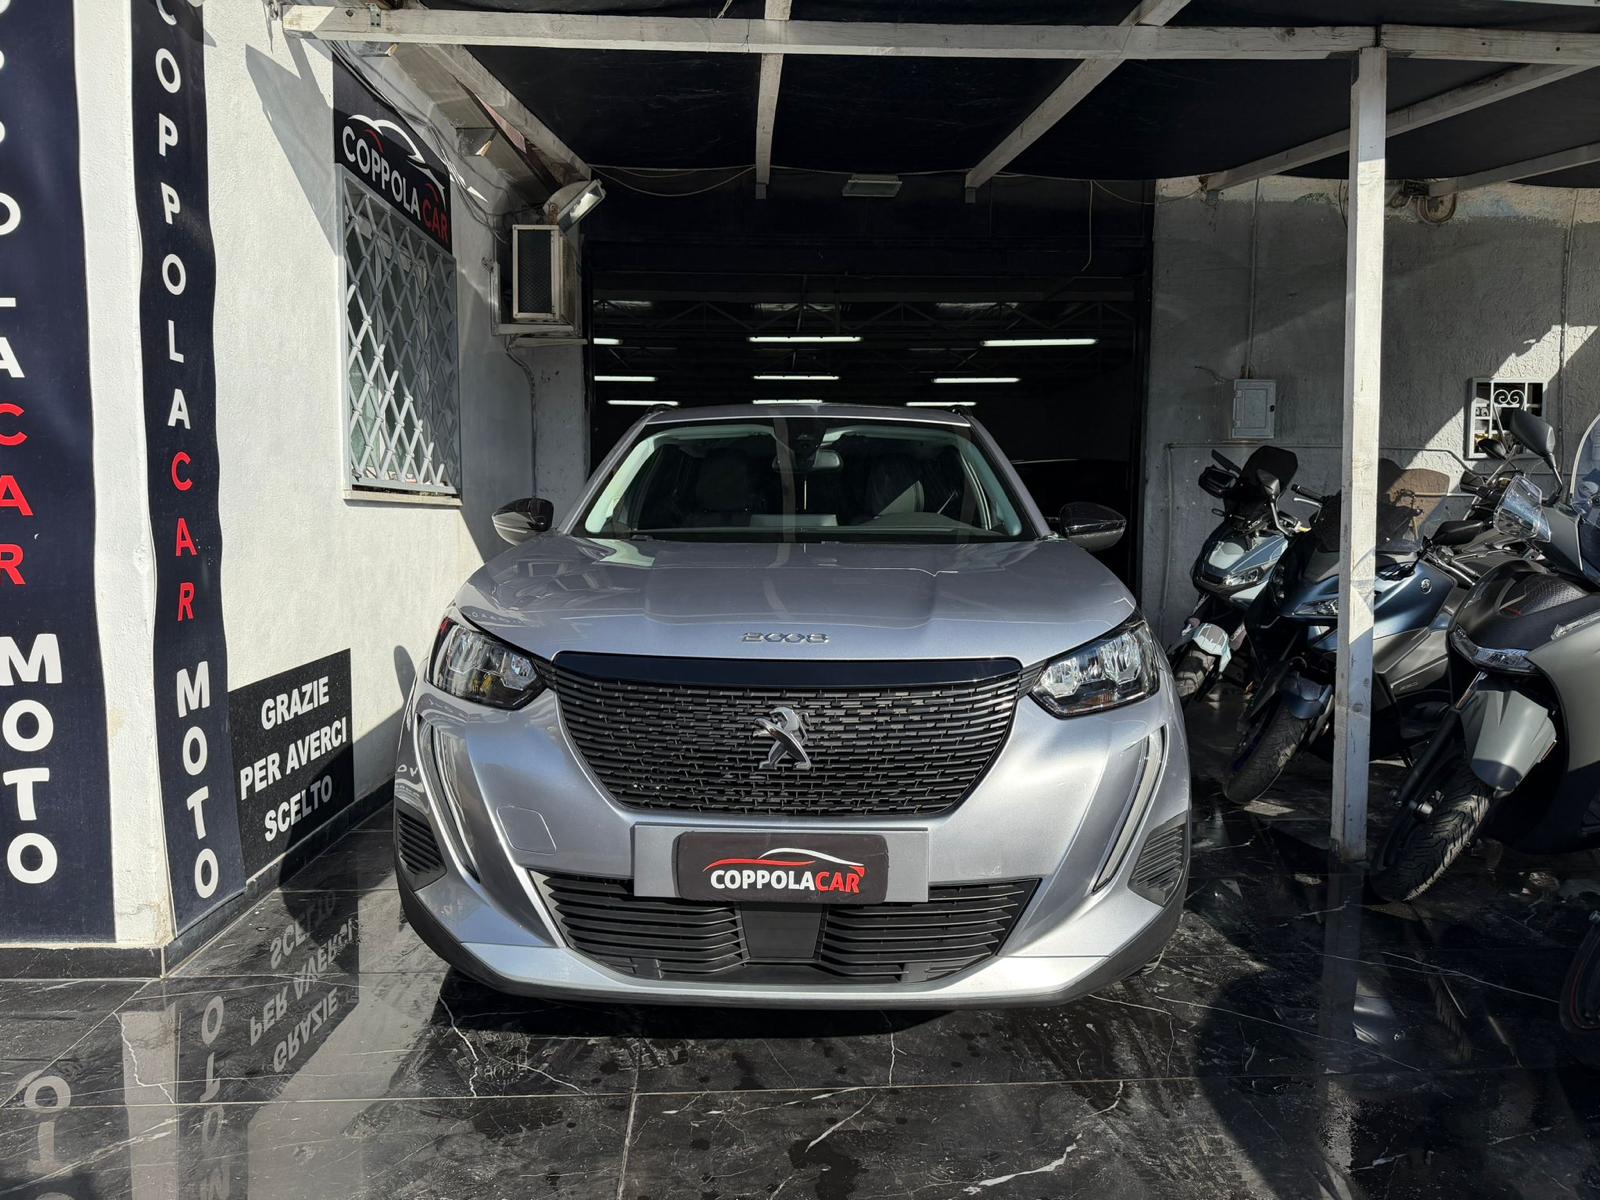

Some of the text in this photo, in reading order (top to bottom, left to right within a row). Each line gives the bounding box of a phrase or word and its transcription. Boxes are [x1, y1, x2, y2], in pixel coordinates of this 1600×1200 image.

[742, 632, 829, 643] 2008
[261, 676, 329, 730] GRAZIE
[0, 633, 62, 884] MOTO
[176, 660, 219, 899] MOTO
[240, 717, 347, 800] PER AVERCI
[264, 775, 333, 842] SCELTO
